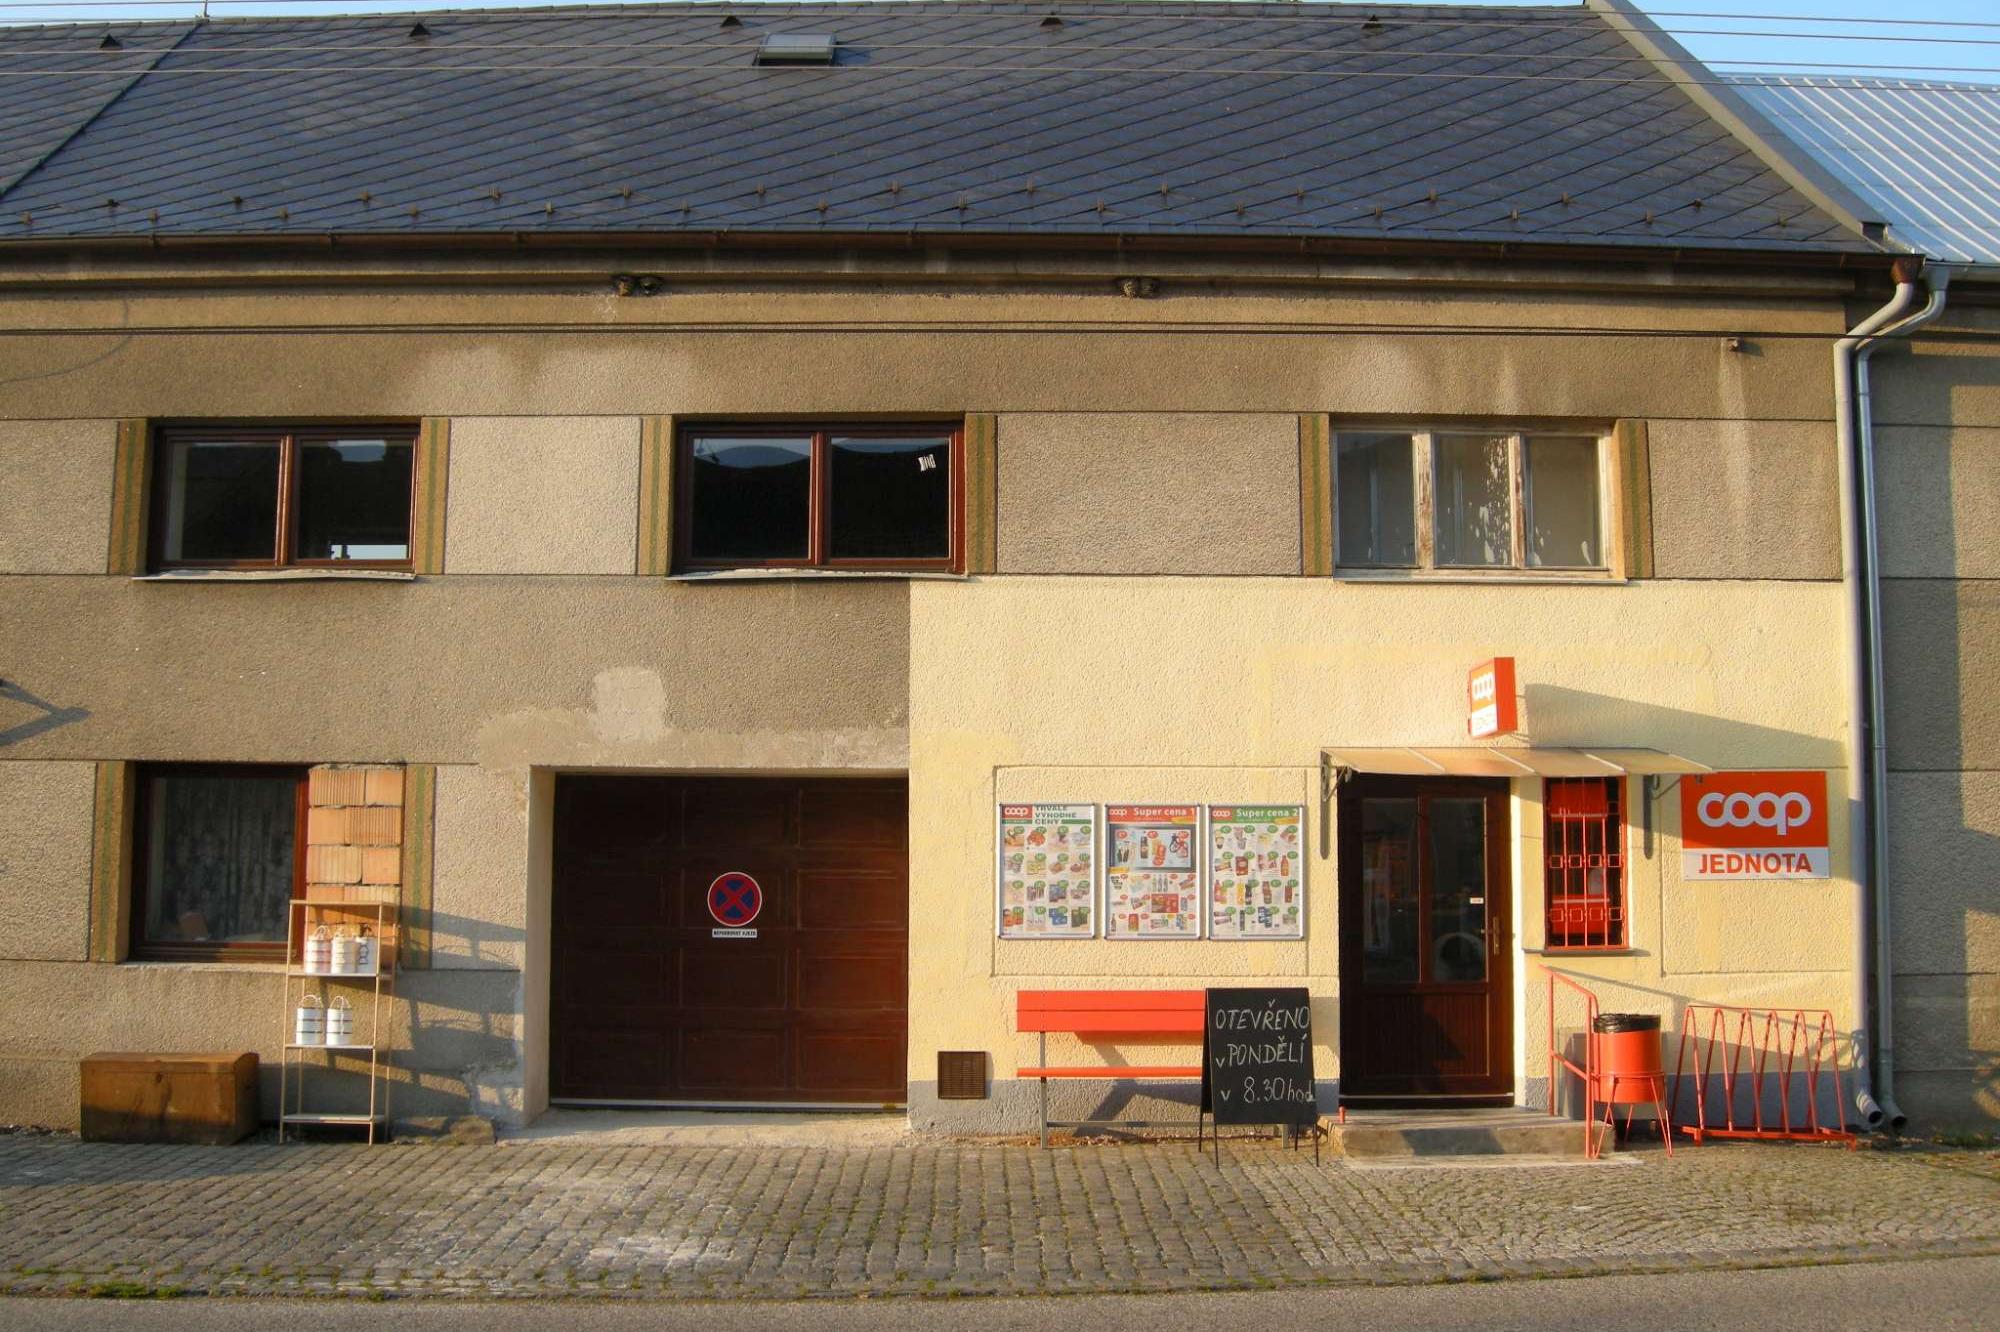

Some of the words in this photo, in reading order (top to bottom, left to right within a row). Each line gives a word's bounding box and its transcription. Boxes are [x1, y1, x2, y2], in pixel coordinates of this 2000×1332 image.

[1472, 672, 1495, 700] coop
[1005, 807, 1029, 817] coop
[1109, 808, 1128, 817] coop
[1134, 807, 1162, 817] Super
[1163, 808, 1187, 816] cena
[1236, 808, 1265, 817] Super
[1266, 809, 1290, 817] cena
[1292, 808, 1299, 816] 2
[1697, 791, 1812, 836] coop
[1699, 853, 1813, 874] JEDNOTA
[1215, 999, 1310, 1030] OTEVŘENO
[1227, 1033, 1307, 1067] PONDĚLÍ
[1244, 1076, 1285, 1103] 8.30
